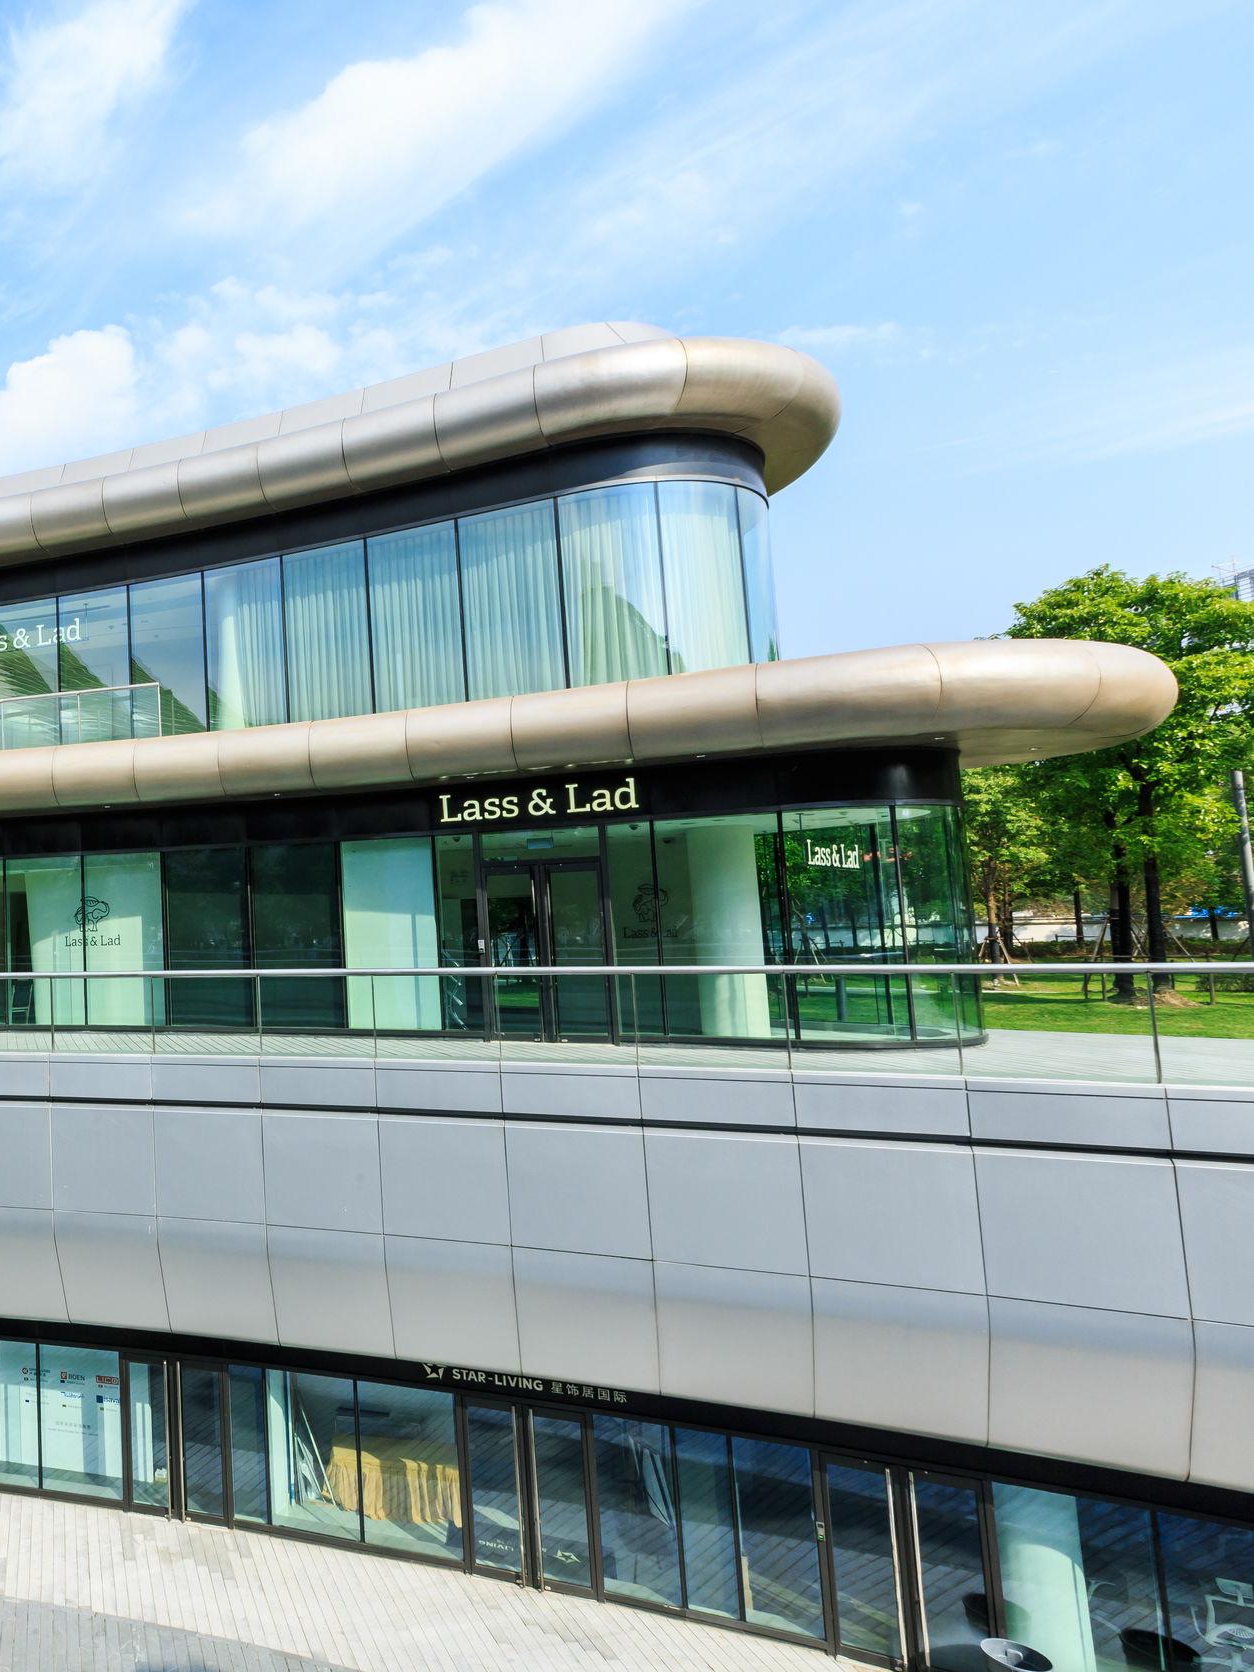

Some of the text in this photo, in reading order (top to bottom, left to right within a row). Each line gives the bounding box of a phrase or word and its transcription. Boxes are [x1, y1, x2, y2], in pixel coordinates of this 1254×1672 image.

[13, 628, 31, 649] &
[36, 618, 81, 646] Lad
[439, 777, 640, 823] Lass & Lad
[807, 839, 860, 869] Lass & Lad
[89, 936, 98, 946] &
[100, 934, 121, 946] Lad
[452, 1368, 544, 1391] STAR-LIVING
[550, 1381, 627, 1403] 星饰居国际
